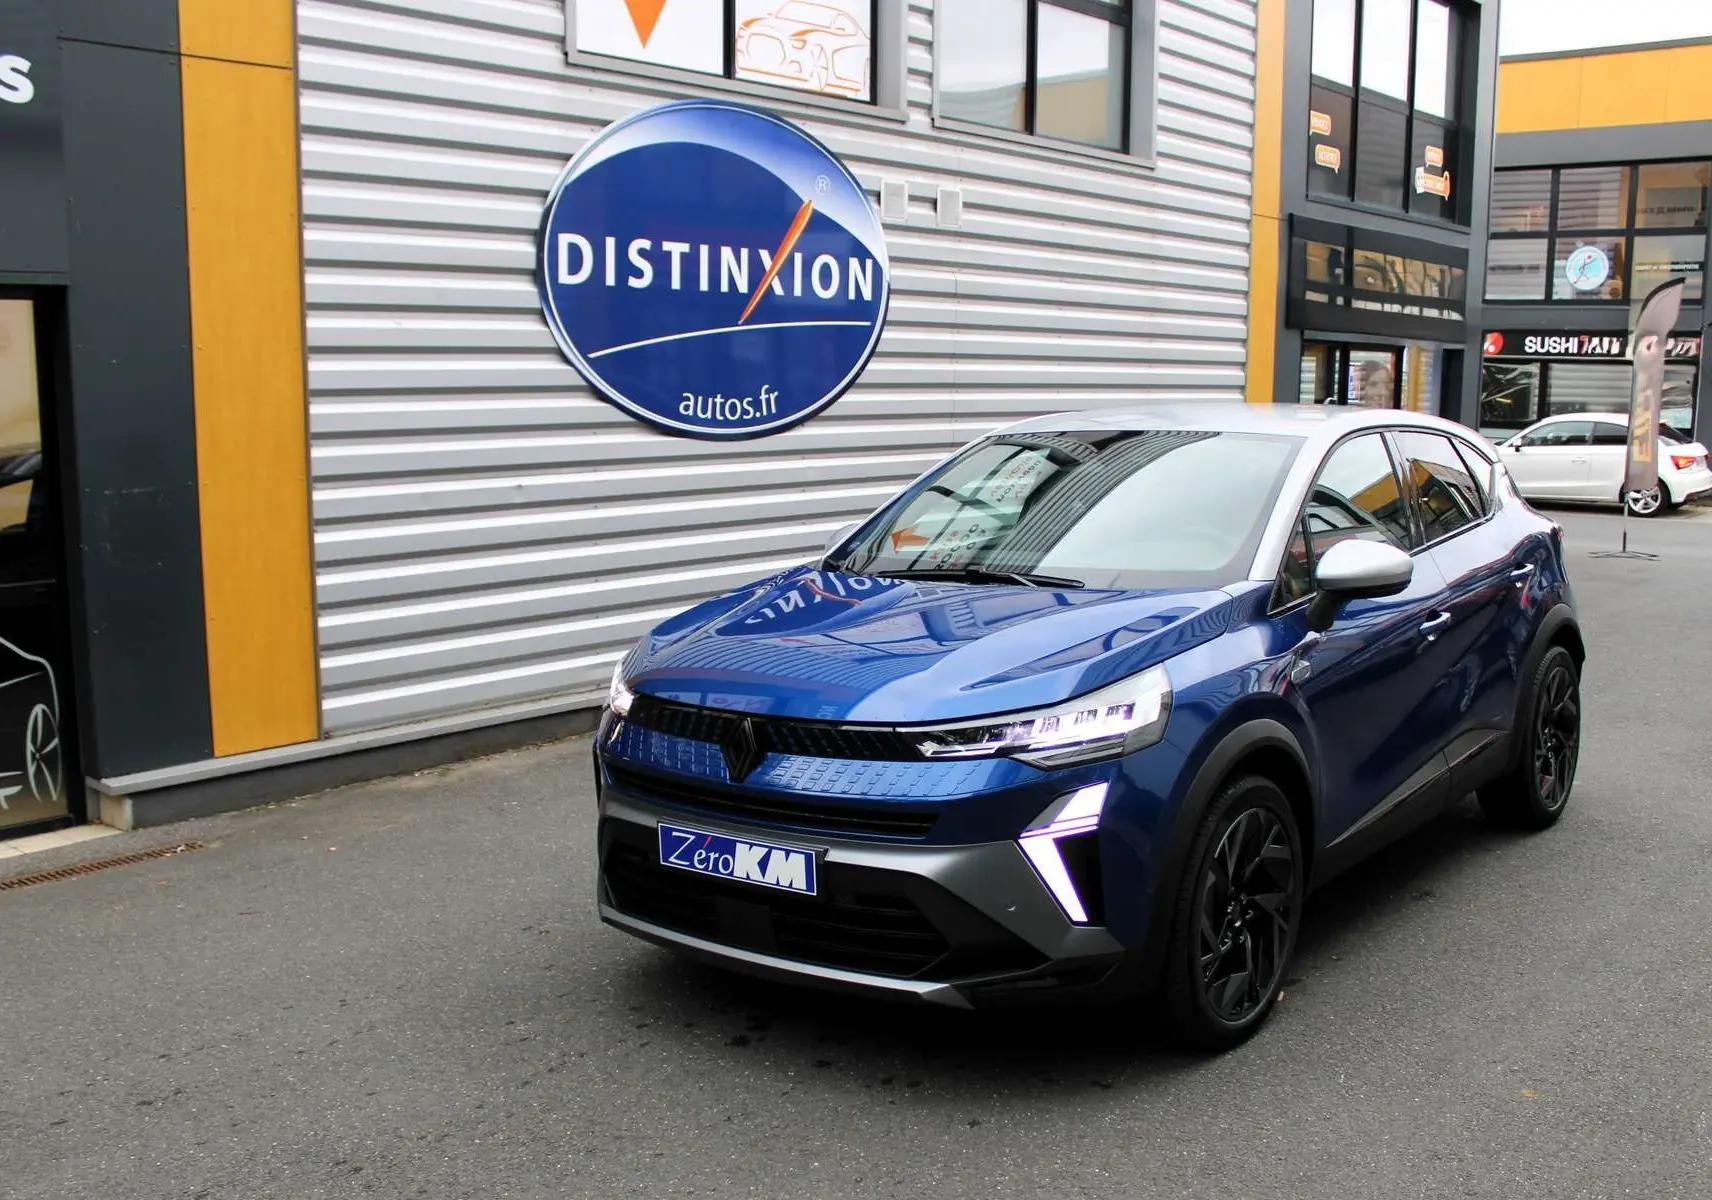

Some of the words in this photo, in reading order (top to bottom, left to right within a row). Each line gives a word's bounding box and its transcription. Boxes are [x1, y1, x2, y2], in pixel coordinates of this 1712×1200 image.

[557, 218, 873, 314] DISTINXION
[1524, 336, 1578, 354] SUSHI
[679, 384, 779, 421] autos.fr
